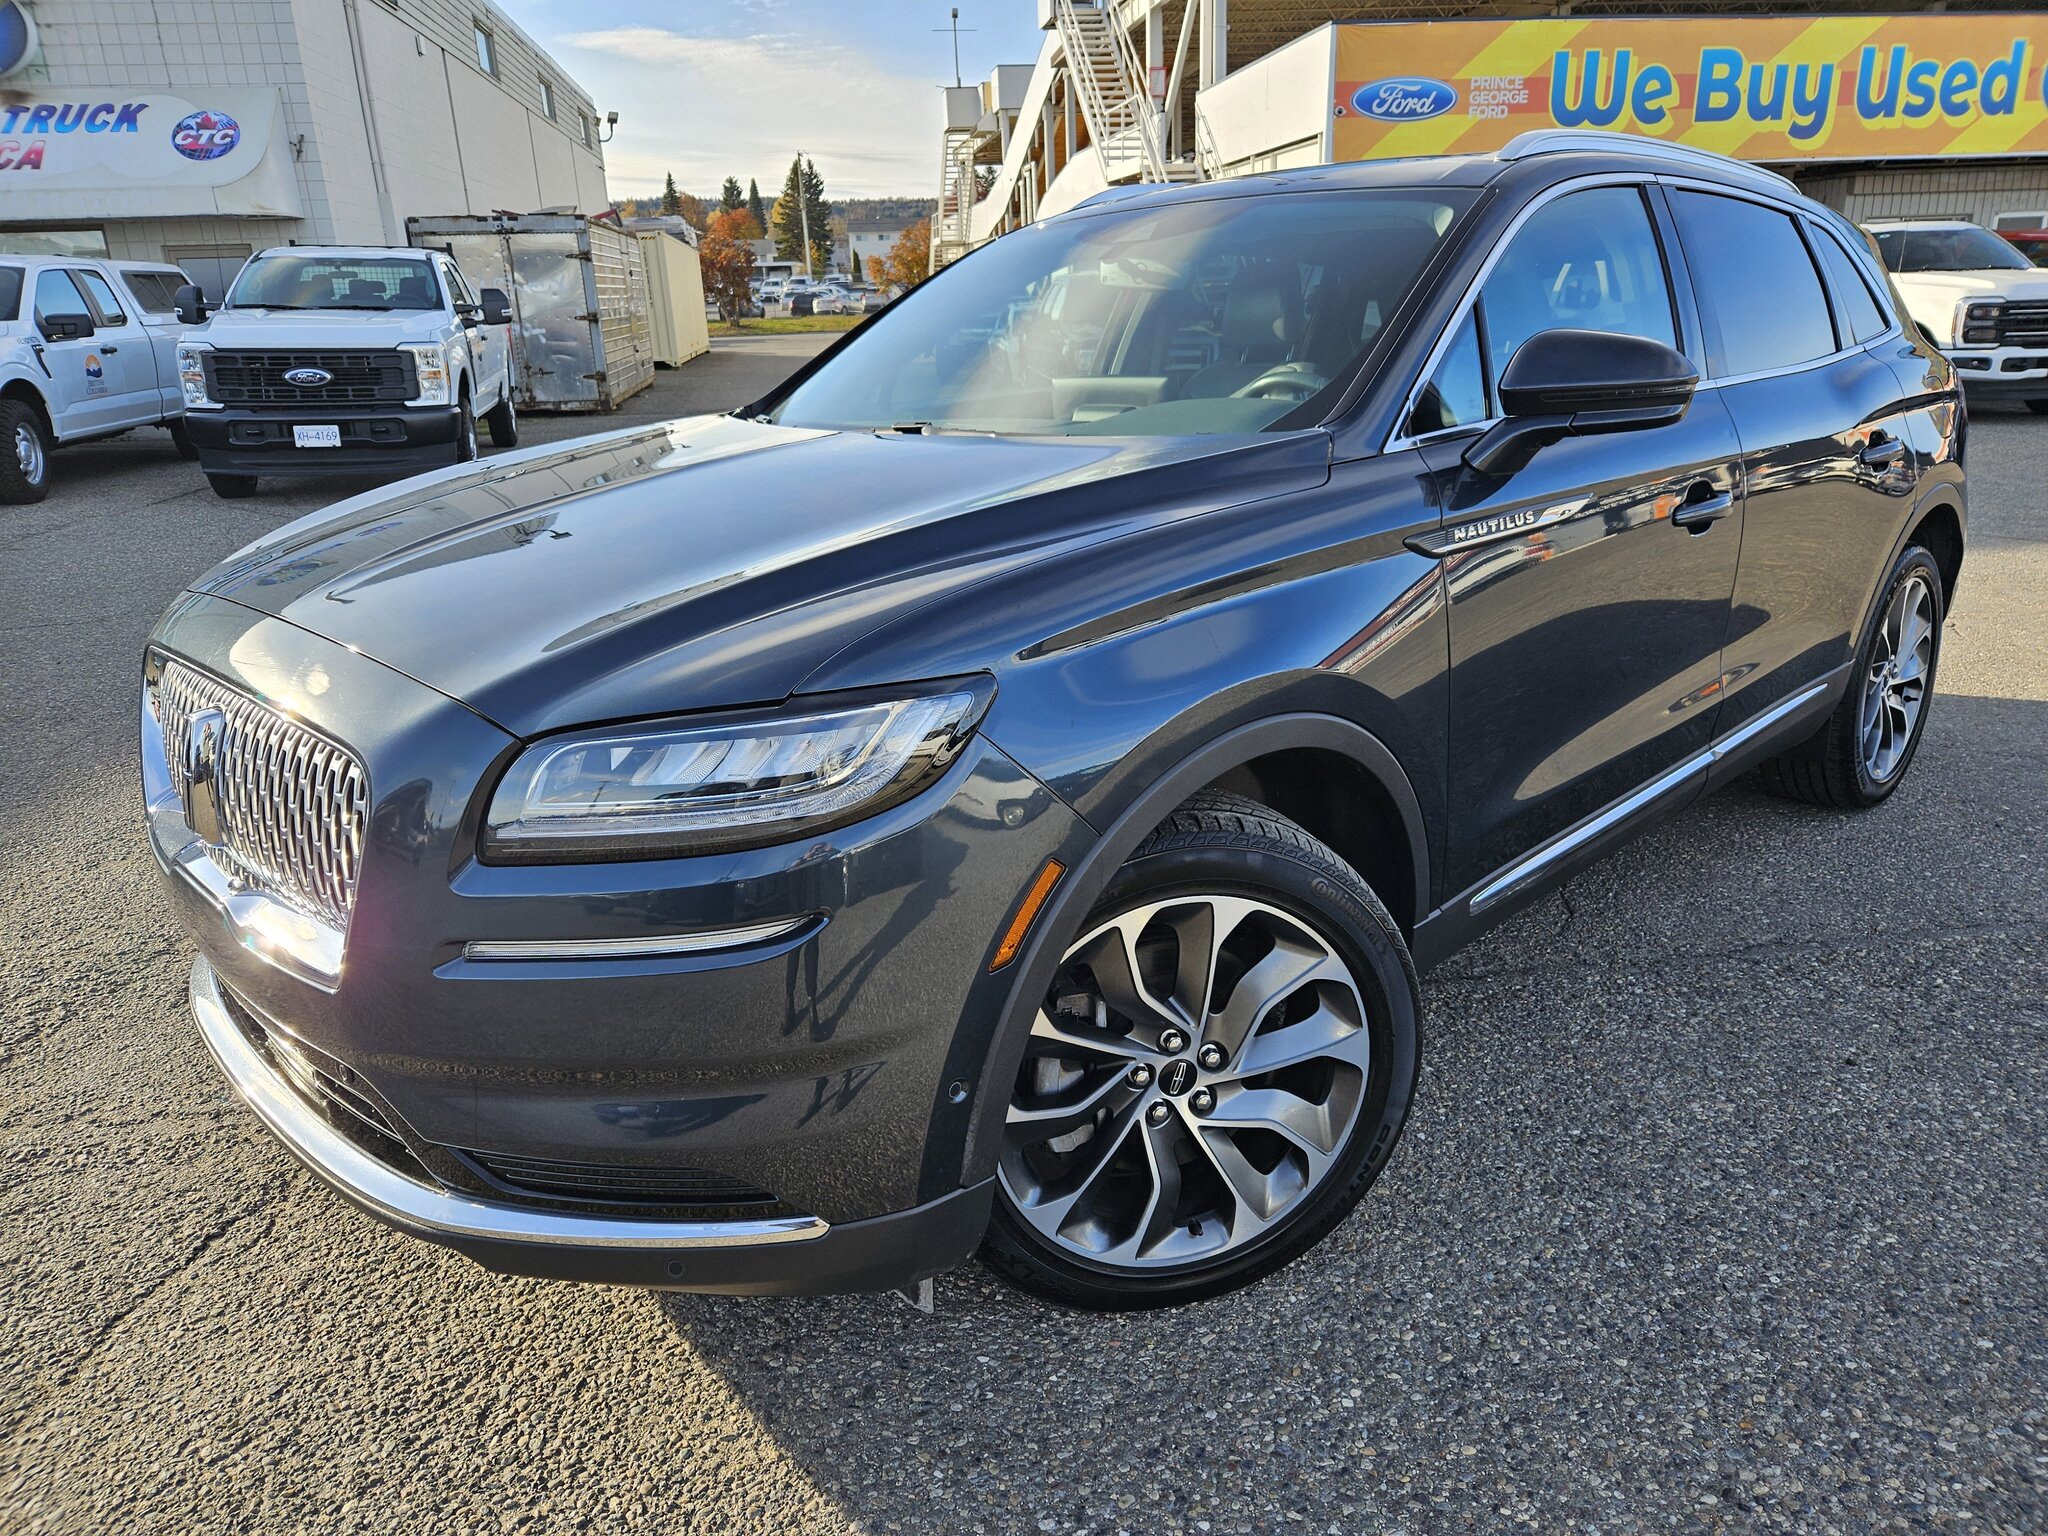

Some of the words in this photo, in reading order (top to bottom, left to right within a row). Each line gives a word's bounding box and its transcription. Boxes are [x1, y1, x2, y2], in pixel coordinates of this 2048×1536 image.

[1470, 76, 1524, 90] PRINCE
[1550, 49, 1674, 128] We
[1693, 47, 1836, 141] Buy
[1855, 38, 2029, 121] Used
[1372, 83, 1437, 114] Ford
[1469, 90, 1528, 104] GEORGE
[1, 103, 150, 134] TRUCK
[1468, 105, 1508, 120] FORD
[174, 128, 236, 146] CTC
[295, 372, 321, 383] Ford
[1454, 510, 1535, 543] NAUTILUS
